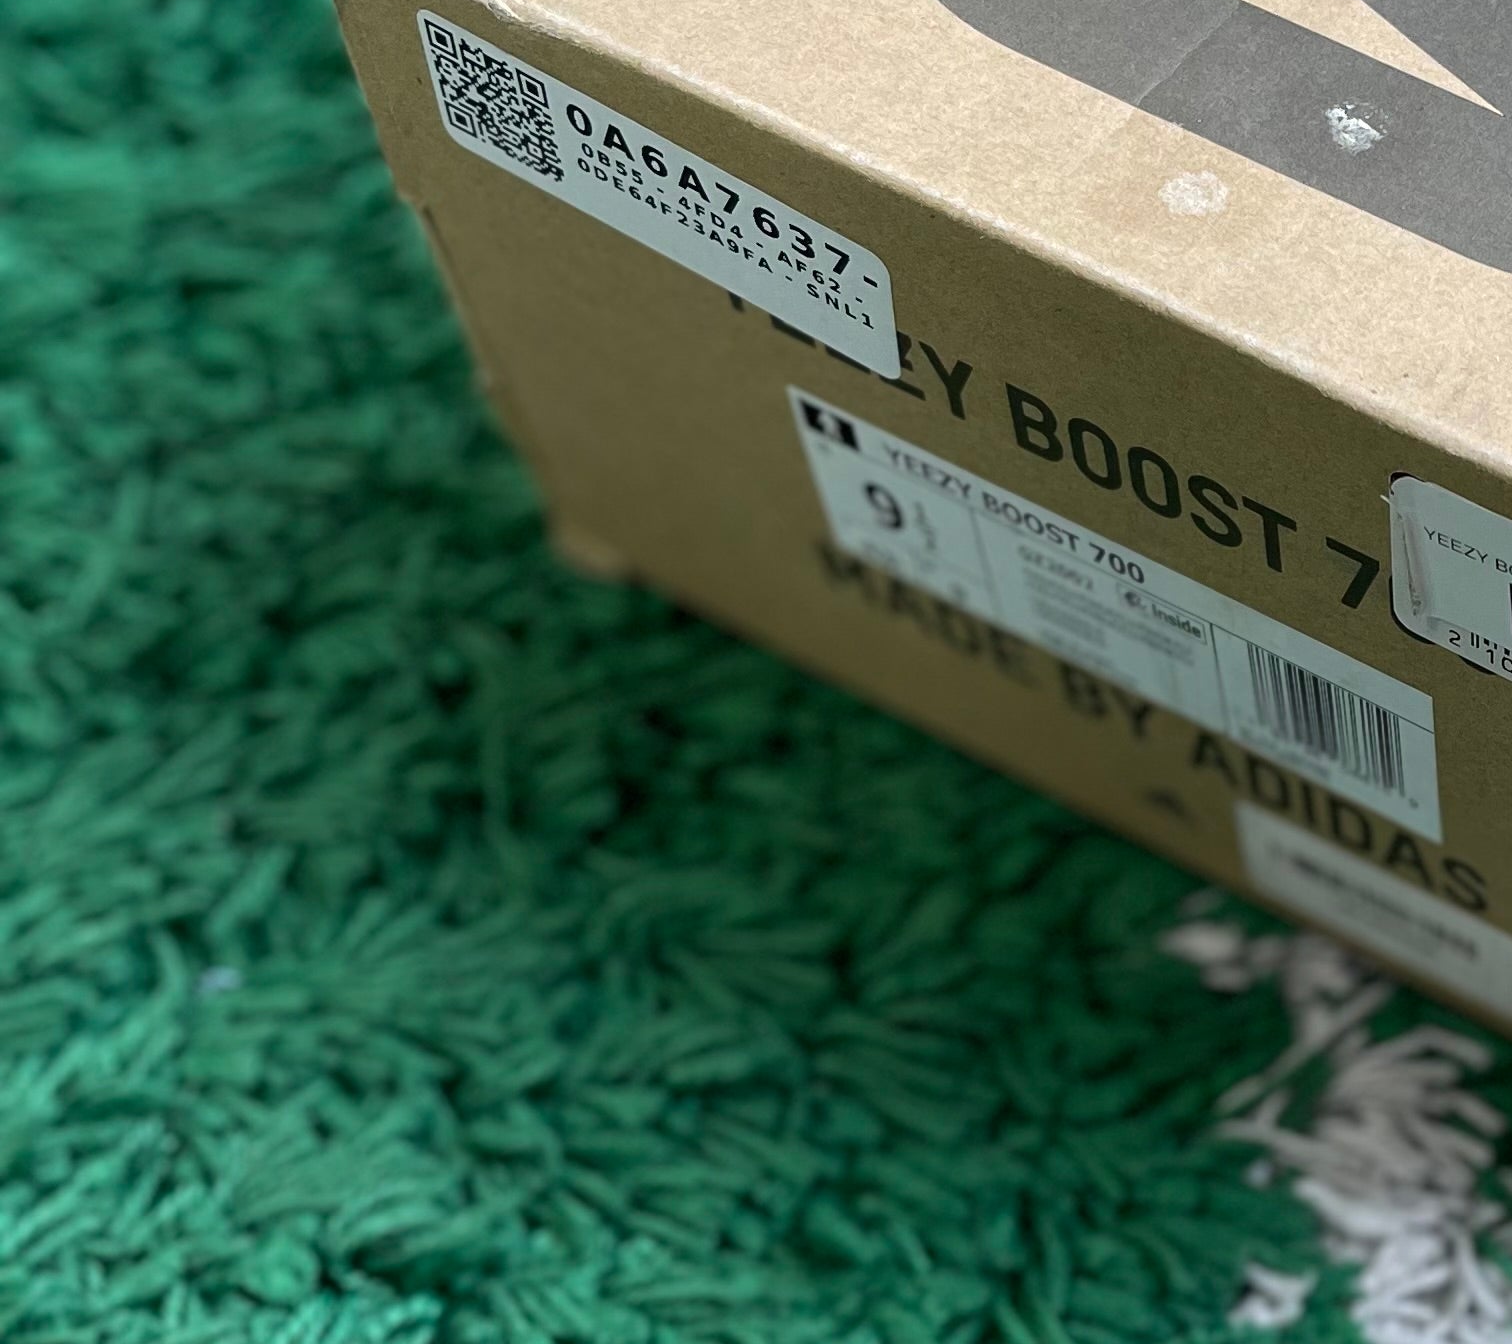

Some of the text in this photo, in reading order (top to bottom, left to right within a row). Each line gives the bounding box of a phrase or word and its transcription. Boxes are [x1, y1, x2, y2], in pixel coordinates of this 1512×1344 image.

[567, 104, 878, 288] 0A6A7637-
[981, 490, 1080, 553] BOOST
[1088, 541, 1145, 585] 700
[1005, 382, 1298, 573] BOOST
[1423, 526, 1488, 564] YEEZY
[1449, 630, 1461, 648] 2
[1190, 735, 1488, 913] ADIDAS
